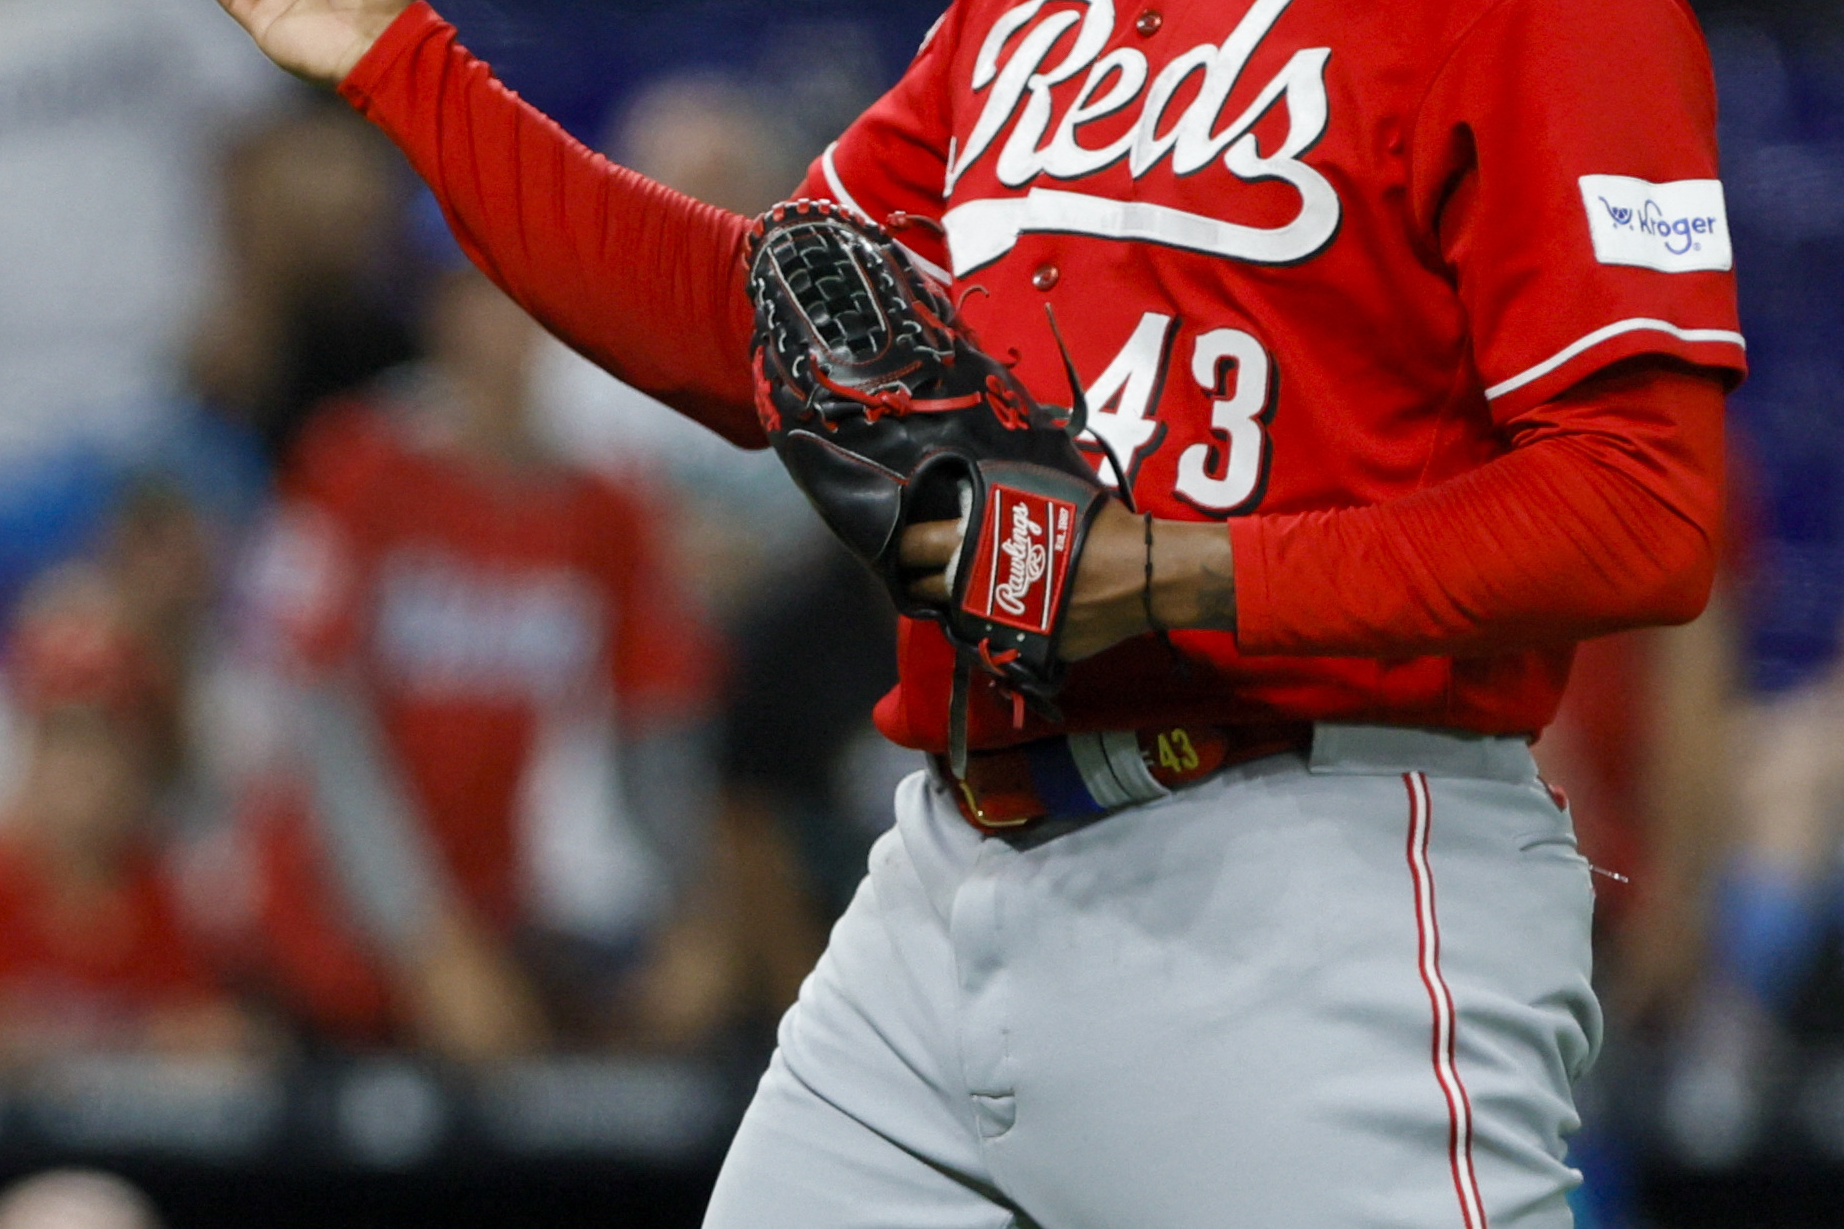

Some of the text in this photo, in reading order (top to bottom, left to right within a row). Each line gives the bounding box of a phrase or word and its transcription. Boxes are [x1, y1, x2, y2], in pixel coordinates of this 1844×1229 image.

[1637, 199, 1716, 255] Kroger
[1075, 311, 1275, 513] 43
[995, 501, 1043, 616] Rawlings
[1157, 727, 1200, 773] 43
